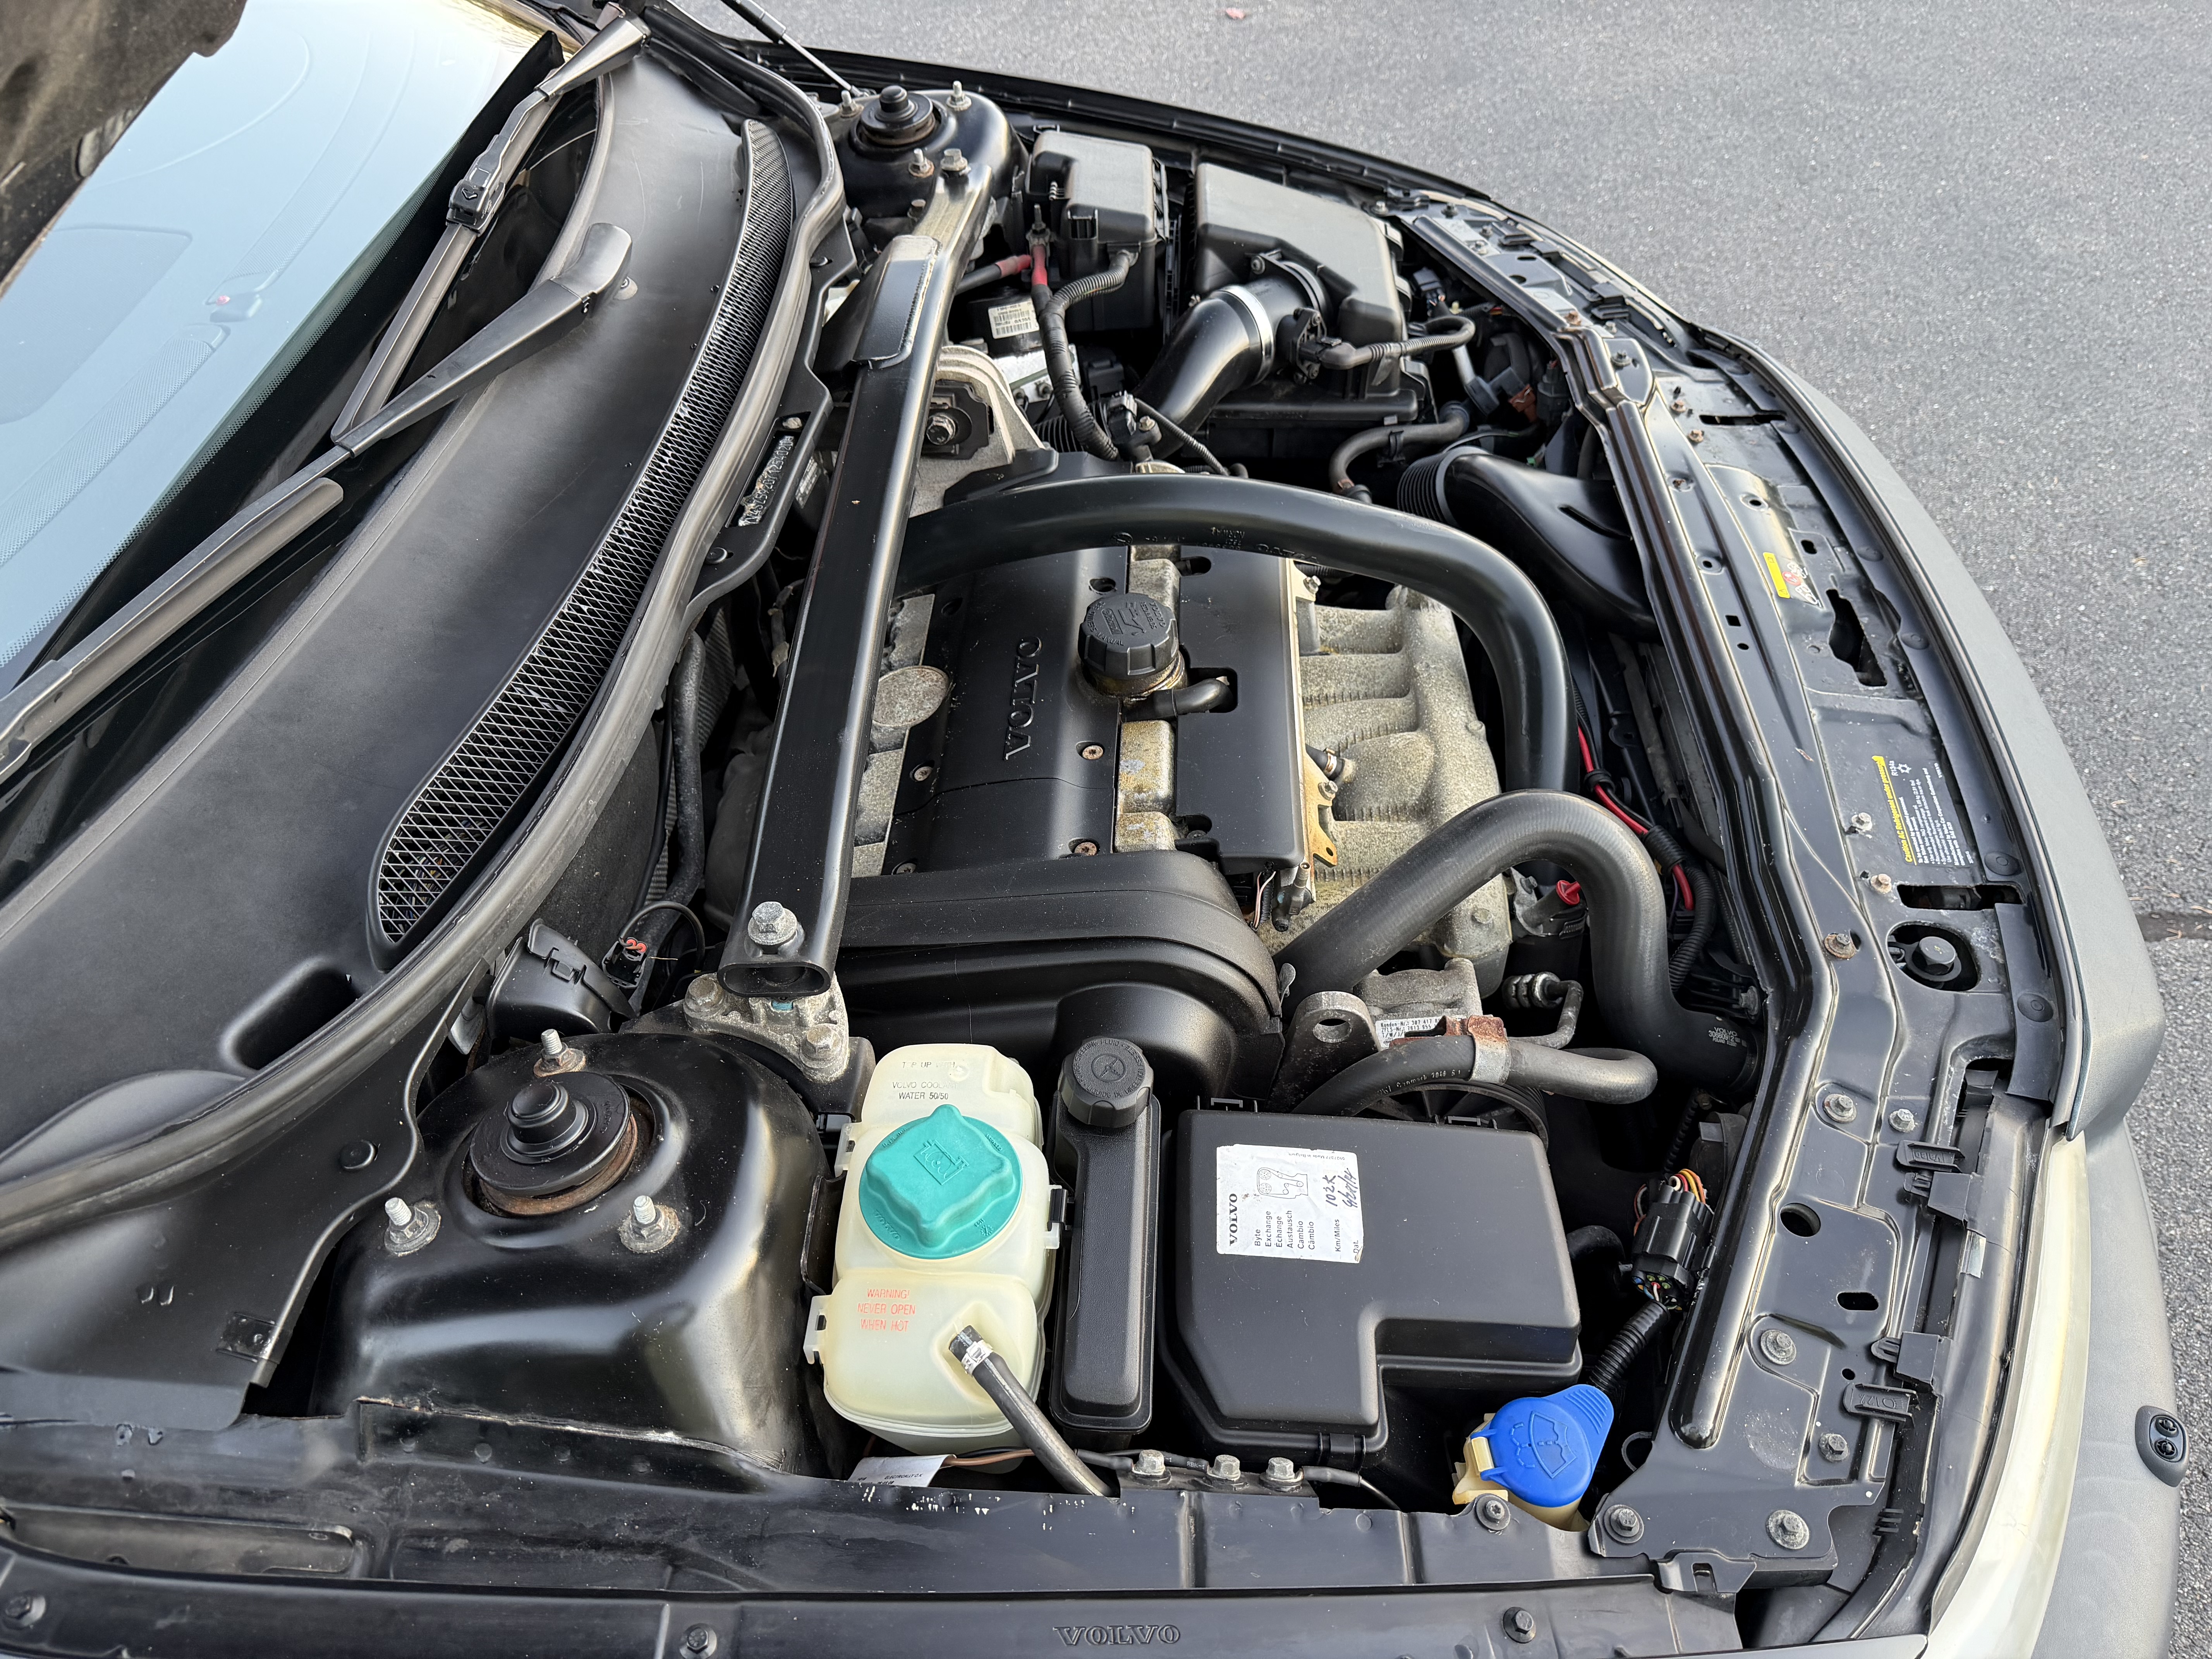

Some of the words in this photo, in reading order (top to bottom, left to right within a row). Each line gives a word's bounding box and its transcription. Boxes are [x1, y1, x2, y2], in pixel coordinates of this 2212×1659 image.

[1002, 636, 1042, 761] VOLVO
[1888, 799, 1903, 830] Refrigerant
[1897, 830, 1905, 839] AC
[1901, 840, 1913, 862] Caution
[1714, 1027, 1737, 1036] VOLVO
[899, 1091, 925, 1099] WATER
[1322, 1175, 1338, 1207] 102K
[874, 1209, 901, 1240] VOLVO
[1229, 1193, 1238, 1247] VOLVO
[1254, 1229, 1262, 1247] Byte
[1274, 1216, 1283, 1248] Échange
[867, 1288, 910, 1298] WARNING!
[857, 1303, 886, 1314] NEVER
[891, 1304, 916, 1315] OPEN
[861, 1319, 886, 1330] WHEN
[891, 1320, 909, 1332] HOT
[1053, 1624, 1181, 1645] VOLVO
